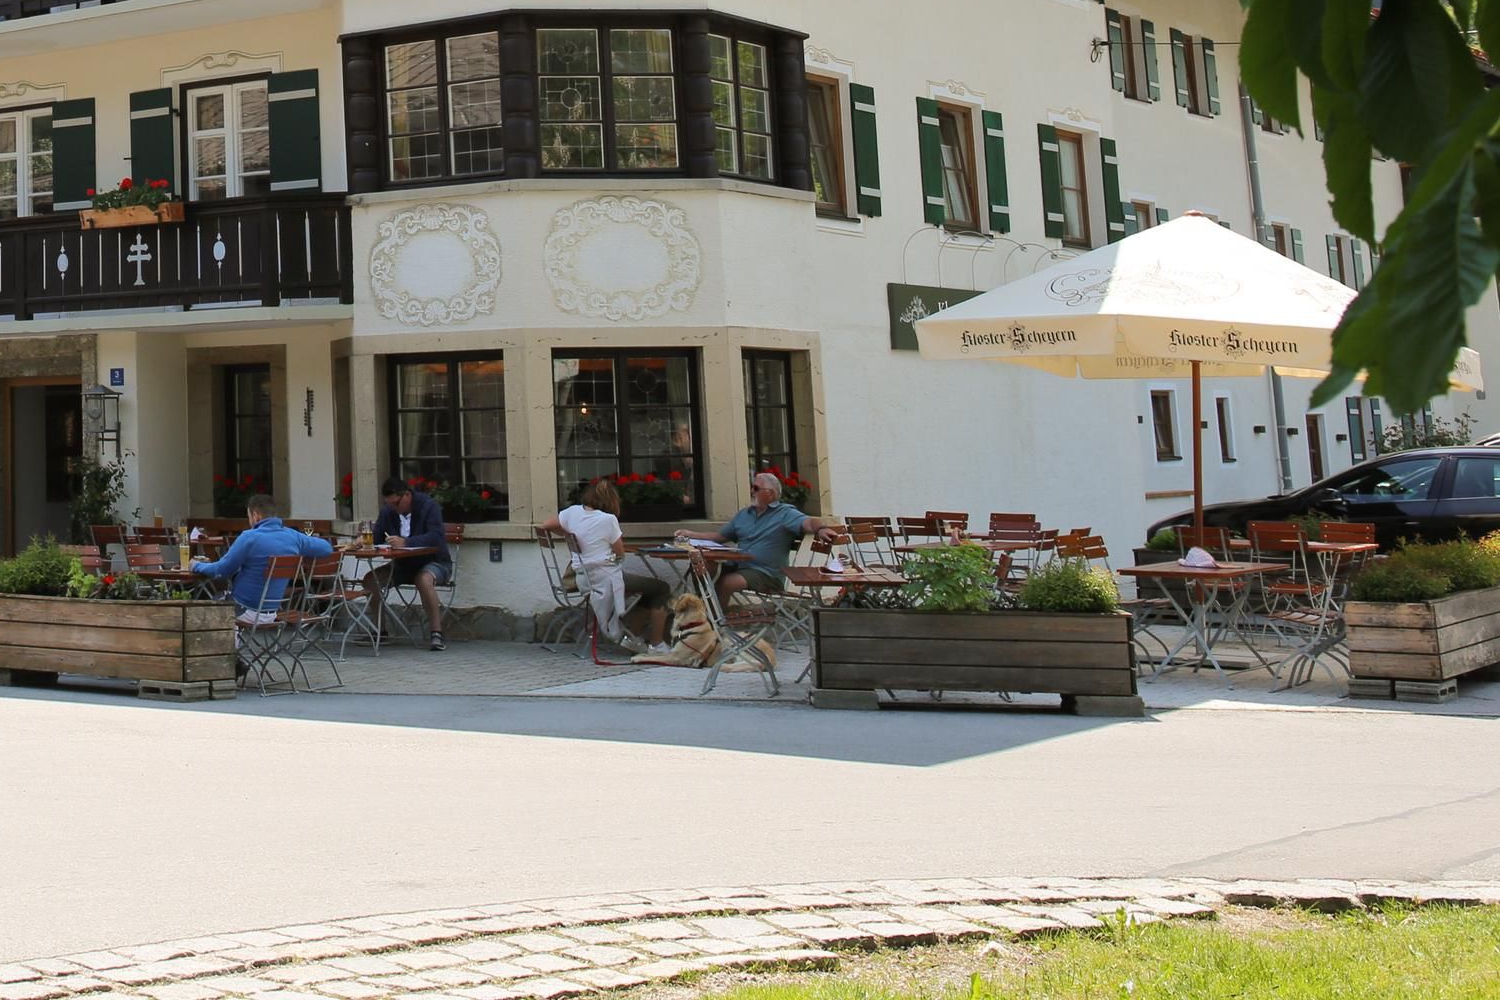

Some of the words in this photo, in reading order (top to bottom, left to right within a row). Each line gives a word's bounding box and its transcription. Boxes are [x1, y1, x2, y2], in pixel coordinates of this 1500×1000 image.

[961, 329, 1006, 353] Kloster
[1012, 326, 1077, 346] Scheyern
[1168, 329, 1220, 352] Kloster
[1225, 331, 1299, 355] Scheyern
[114, 370, 120, 378] 3
